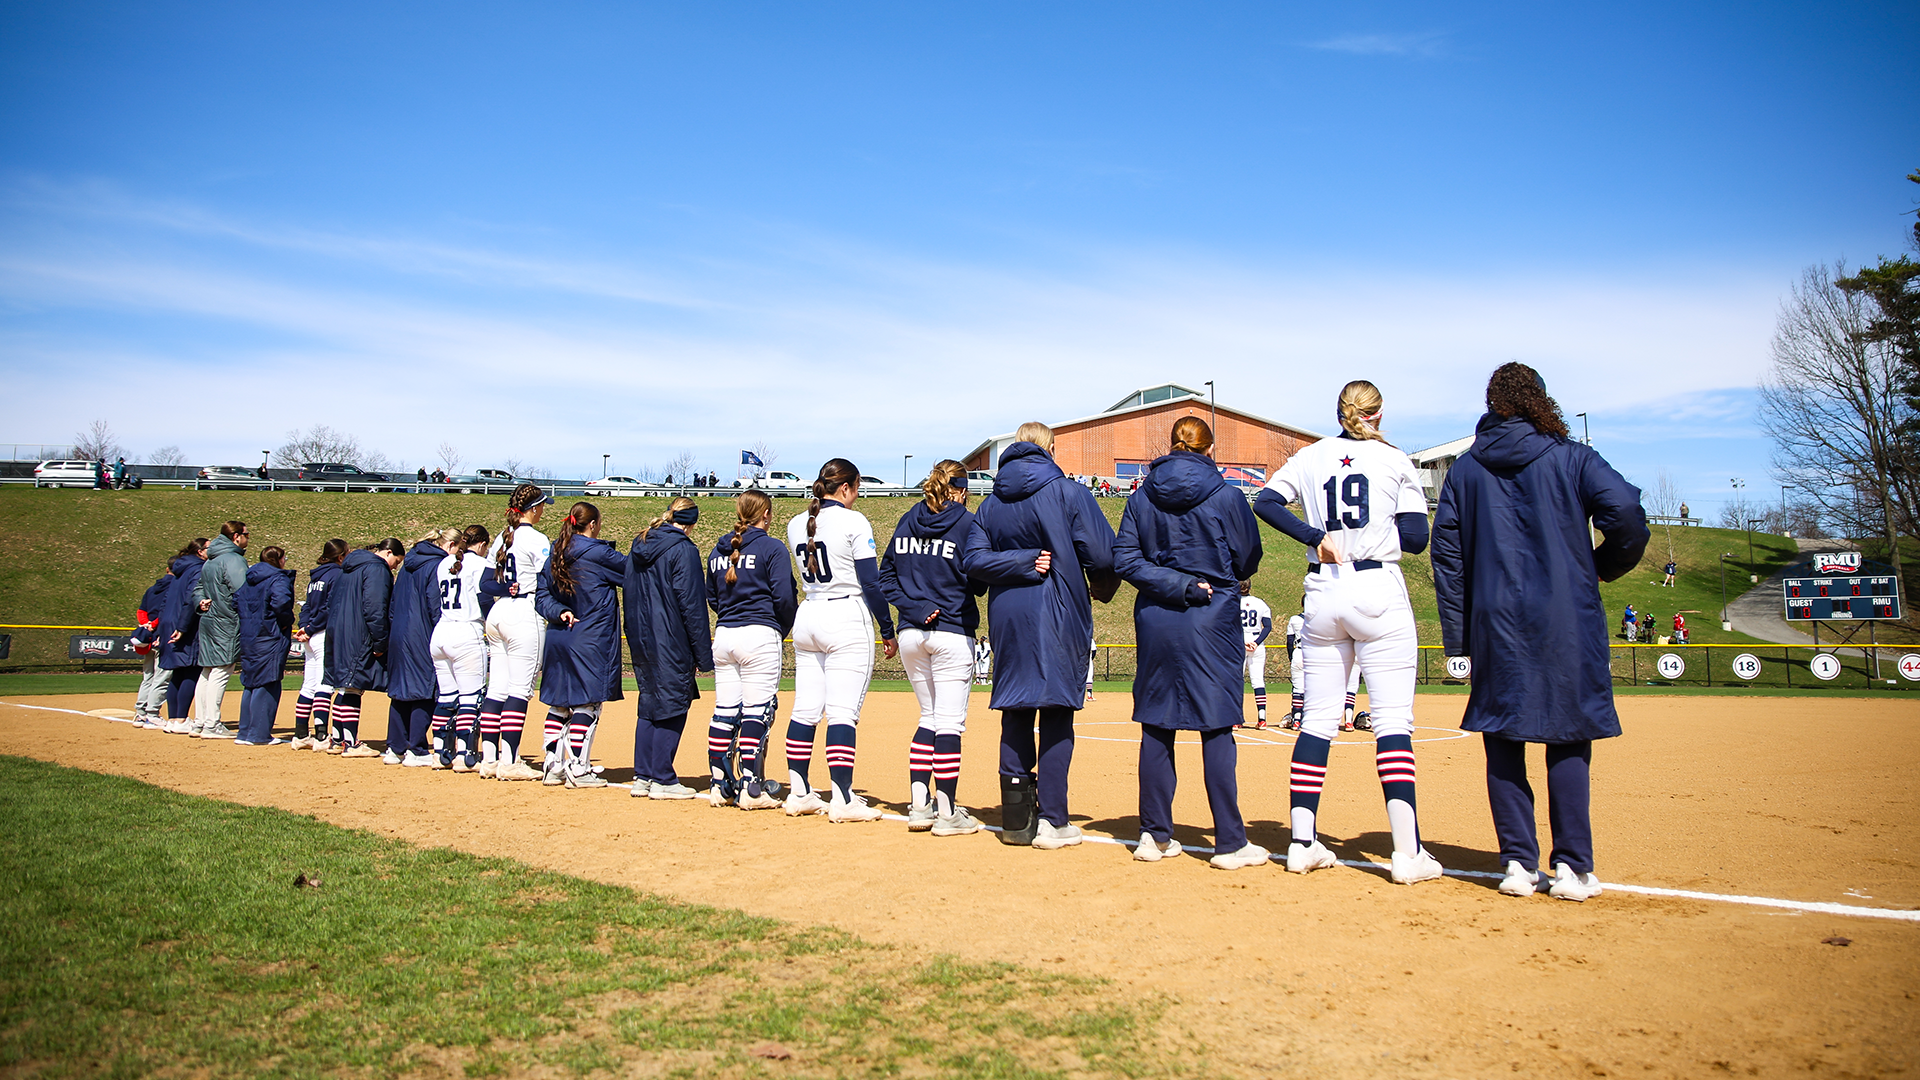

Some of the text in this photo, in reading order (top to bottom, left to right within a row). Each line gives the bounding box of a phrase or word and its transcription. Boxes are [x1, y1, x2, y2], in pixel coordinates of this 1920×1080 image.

[1323, 473, 1370, 532] 19
[895, 537, 957, 560] UNITE
[796, 541, 833, 583] 30
[1815, 554, 1860, 569] RMU
[440, 578, 462, 609] 27
[1792, 586, 1800, 597] 0
[1820, 585, 1828, 597] 0
[1852, 584, 1860, 596] 0
[1789, 599, 1813, 607] GUEST
[1872, 597, 1891, 605] RMU
[1802, 606, 1811, 618] 0
[1883, 605, 1892, 617] 0
[1240, 609, 1257, 627] 28
[80, 639, 113, 652] RMU
[1452, 661, 1467, 671] 16
[1663, 661, 1679, 671] 14
[1738, 661, 1756, 671] 18
[1822, 661, 1829, 671] 1
